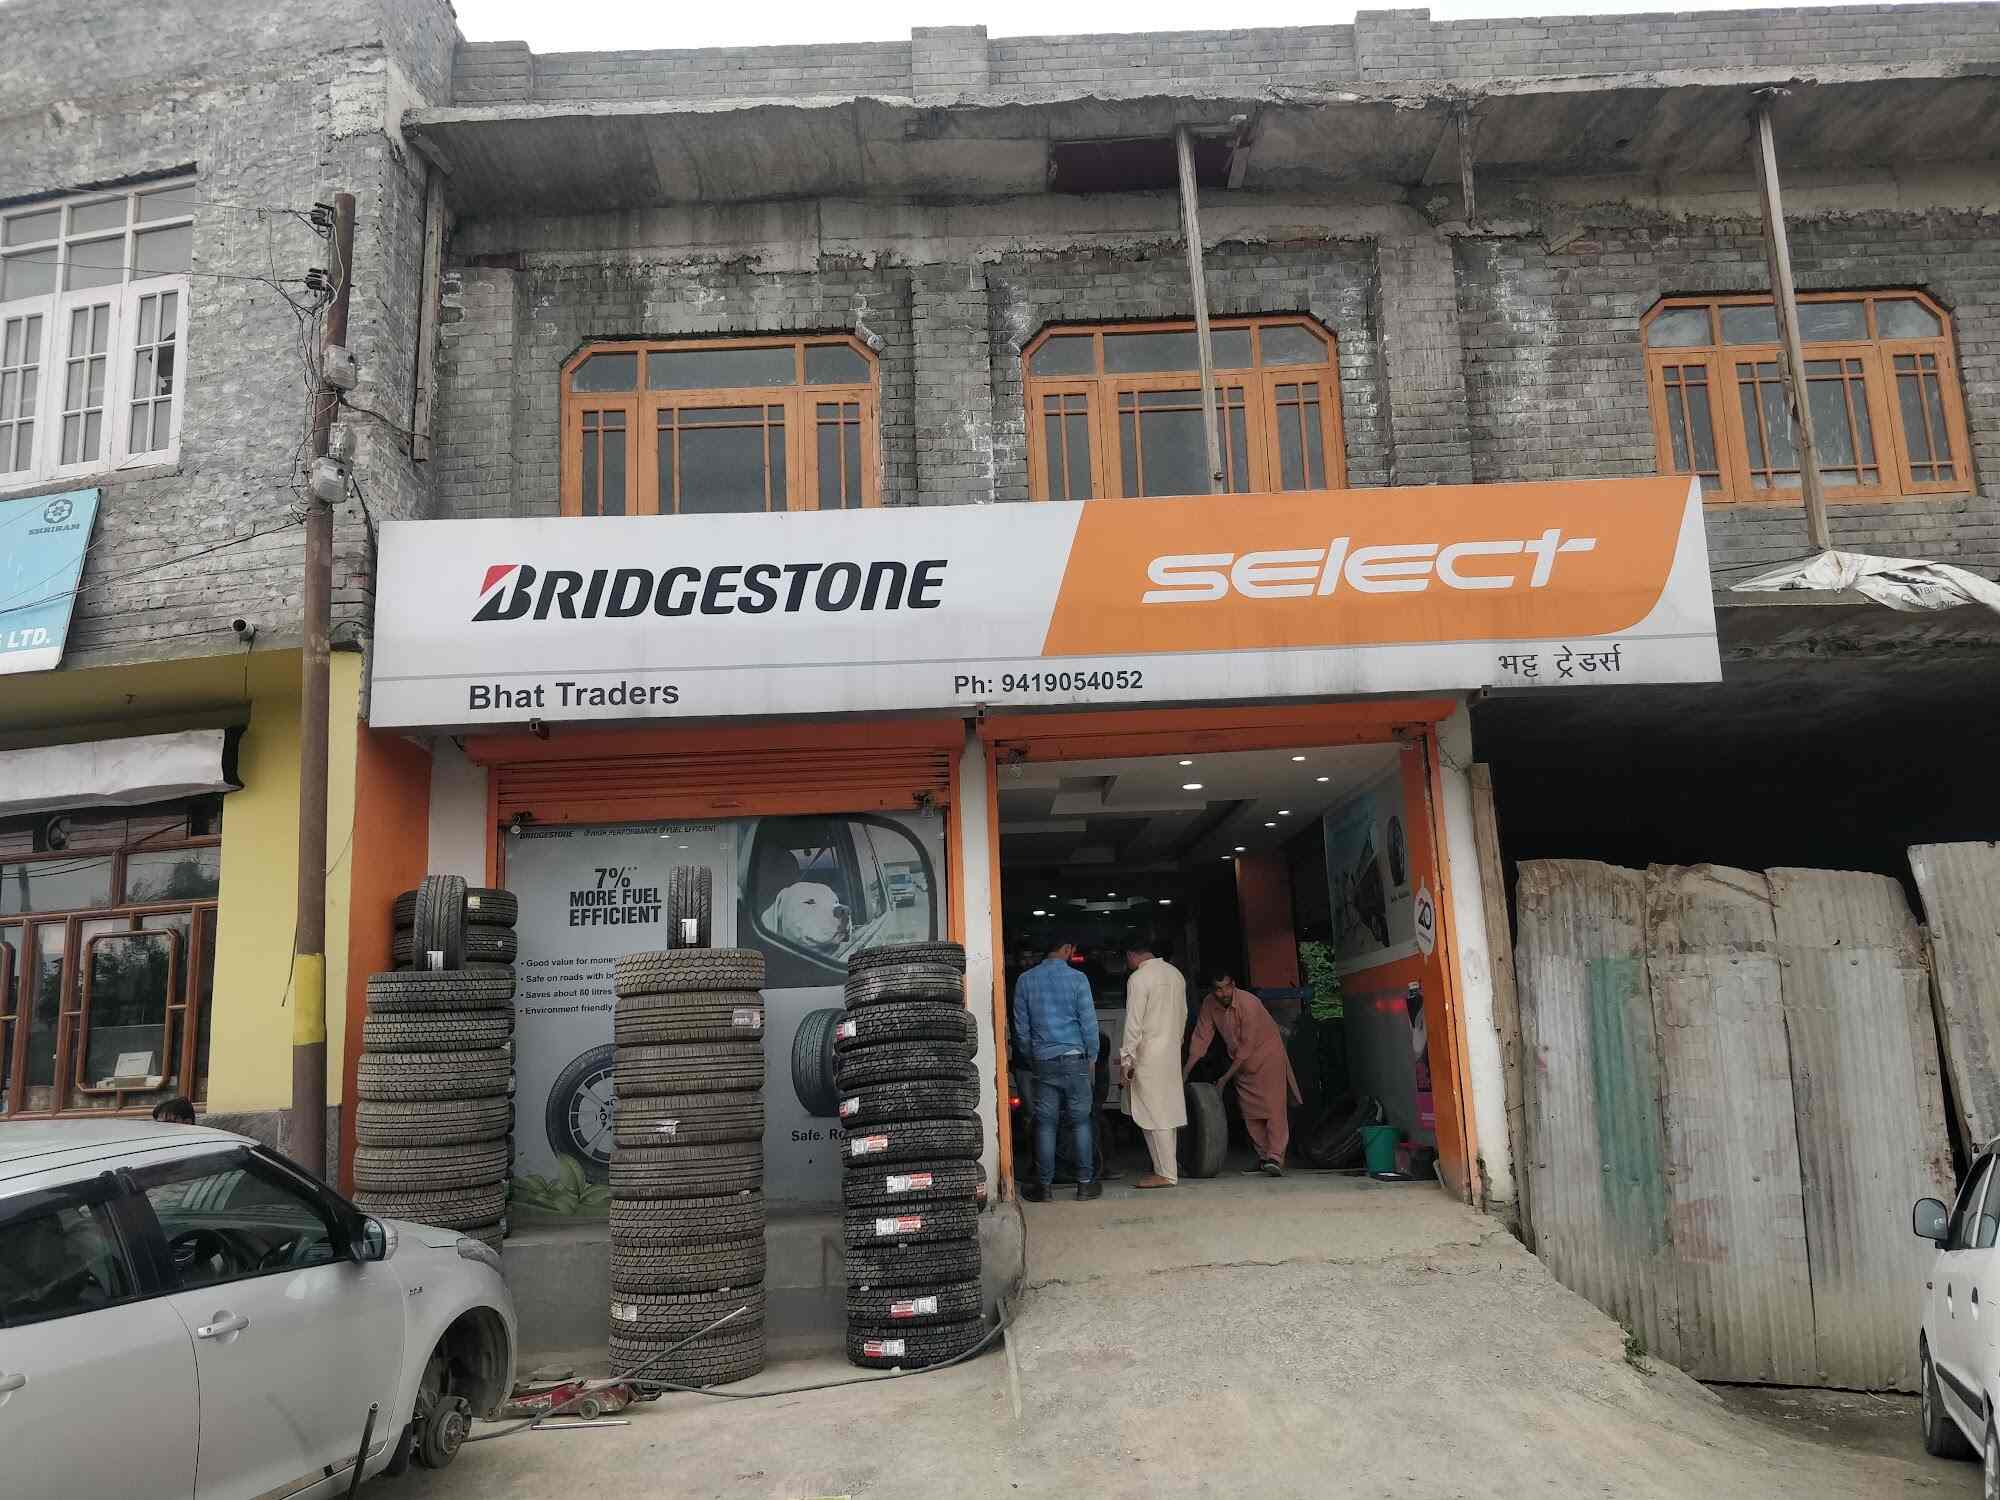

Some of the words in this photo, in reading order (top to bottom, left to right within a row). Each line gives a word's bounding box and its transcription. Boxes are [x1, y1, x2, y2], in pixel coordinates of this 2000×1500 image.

[470, 559, 948, 622] BRIDGESTONE
[7, 627, 50, 648] LTD.
[954, 675, 993, 694] Ph:
[1002, 670, 1144, 692] 9419054052
[469, 683, 545, 710] Bhat
[555, 681, 680, 707] Traders
[569, 889, 617, 907] MORE
[622, 887, 662, 905] FUEL
[569, 904, 662, 927] EFFICIENT
[526, 959, 549, 967] Good
[552, 958, 574, 966] value
[576, 957, 588, 965] for
[526, 975, 544, 983] Safe
[560, 973, 584, 981] roads
[586, 972, 604, 980] with
[526, 991, 551, 999] Saves
[554, 989, 577, 997] about
[525, 1006, 578, 1015] Environment
[581, 1003, 613, 1013] friendly
[791, 1129, 824, 1141] Safe.
